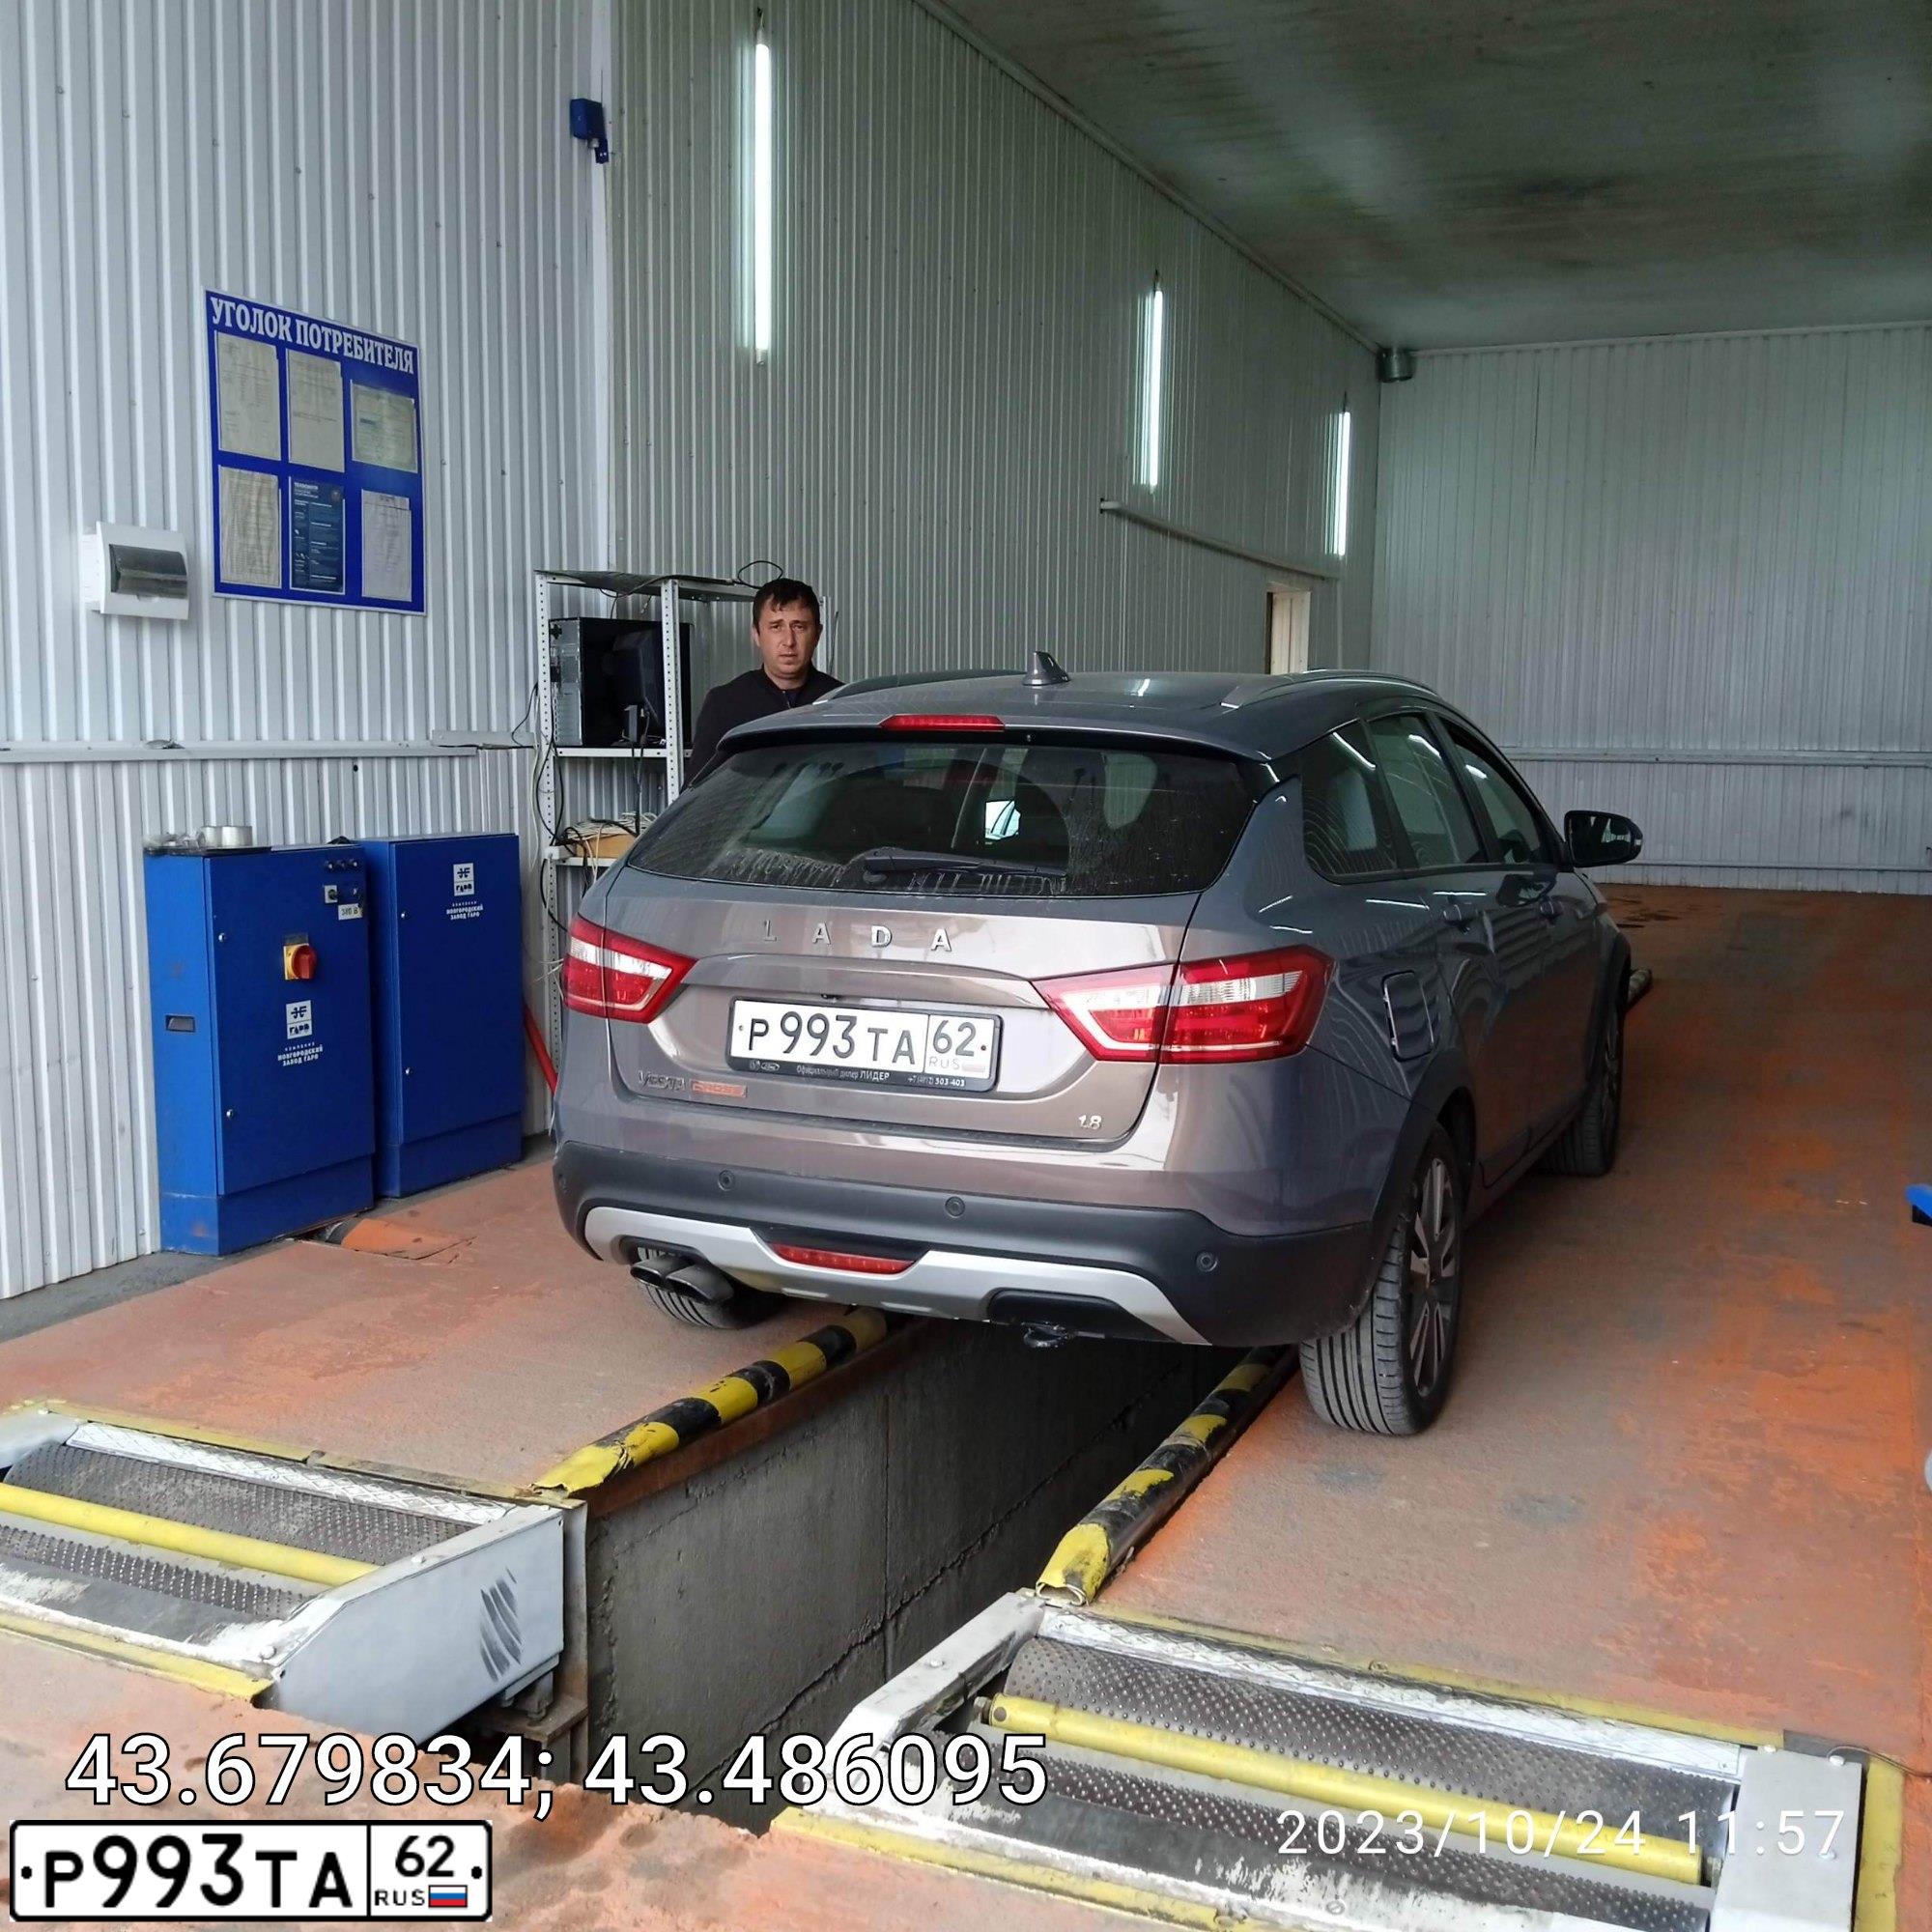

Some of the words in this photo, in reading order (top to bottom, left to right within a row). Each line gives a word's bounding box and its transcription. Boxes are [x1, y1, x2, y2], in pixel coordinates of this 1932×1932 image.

[210, 296, 292, 343] УГОЛОК
[295, 320, 414, 374] ПОТРЕБИТЕЛЯ
[762, 919, 952, 952] LADA
[748, 1010, 916, 1065] Р993ТА
[932, 1019, 977, 1058] 62
[277, 1044, 323, 1061] НОВГОРОДСКИЙ
[283, 1057, 302, 1066] ЗАВОД
[928, 1056, 970, 1070] RUS
[839, 1069, 859, 1080] дилер
[859, 1070, 890, 1081] ЛИДЕР
[934, 1077, 949, 1086] 503
[950, 1079, 965, 1088] 403
